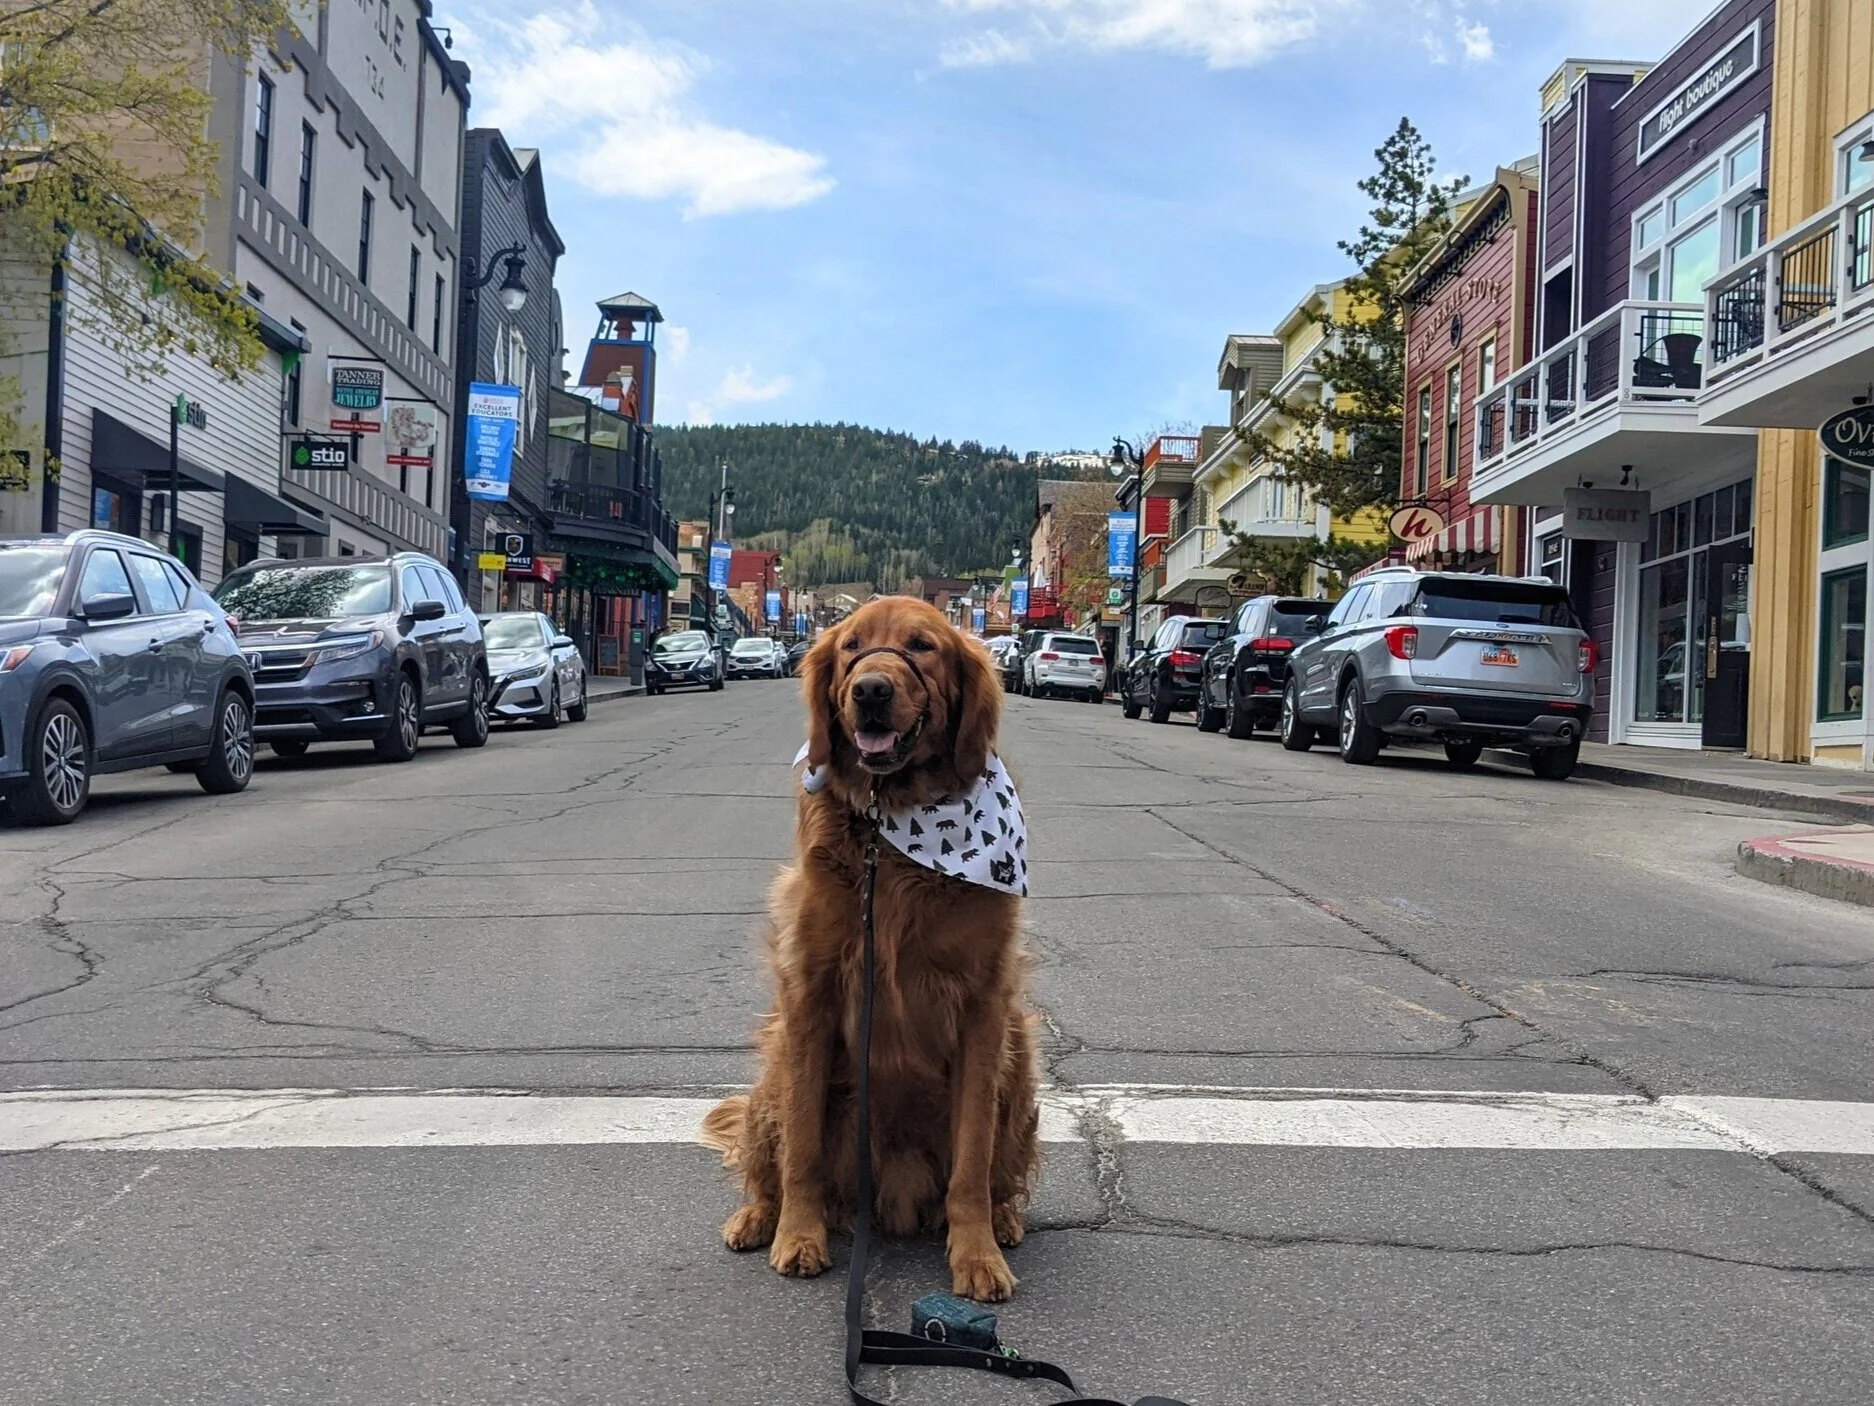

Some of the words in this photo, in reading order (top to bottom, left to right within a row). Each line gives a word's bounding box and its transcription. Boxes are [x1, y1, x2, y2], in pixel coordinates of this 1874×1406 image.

[1659, 98, 1684, 133] flight
[1686, 59, 1734, 109] boutique
[1417, 286, 1463, 363] GENERAL
[1467, 278, 1501, 304] STORE
[335, 369, 381, 380] TANNER
[335, 377, 381, 385] TRADING
[334, 393, 376, 408] JEWELRY
[474, 402, 512, 412] EXCELLENT
[471, 408, 513, 417] EDUCATORS
[1835, 416, 1874, 444] Ov
[311, 447, 345, 463] stio
[1848, 448, 1867, 457] Fine
[1577, 507, 1641, 522] FLIGHT
